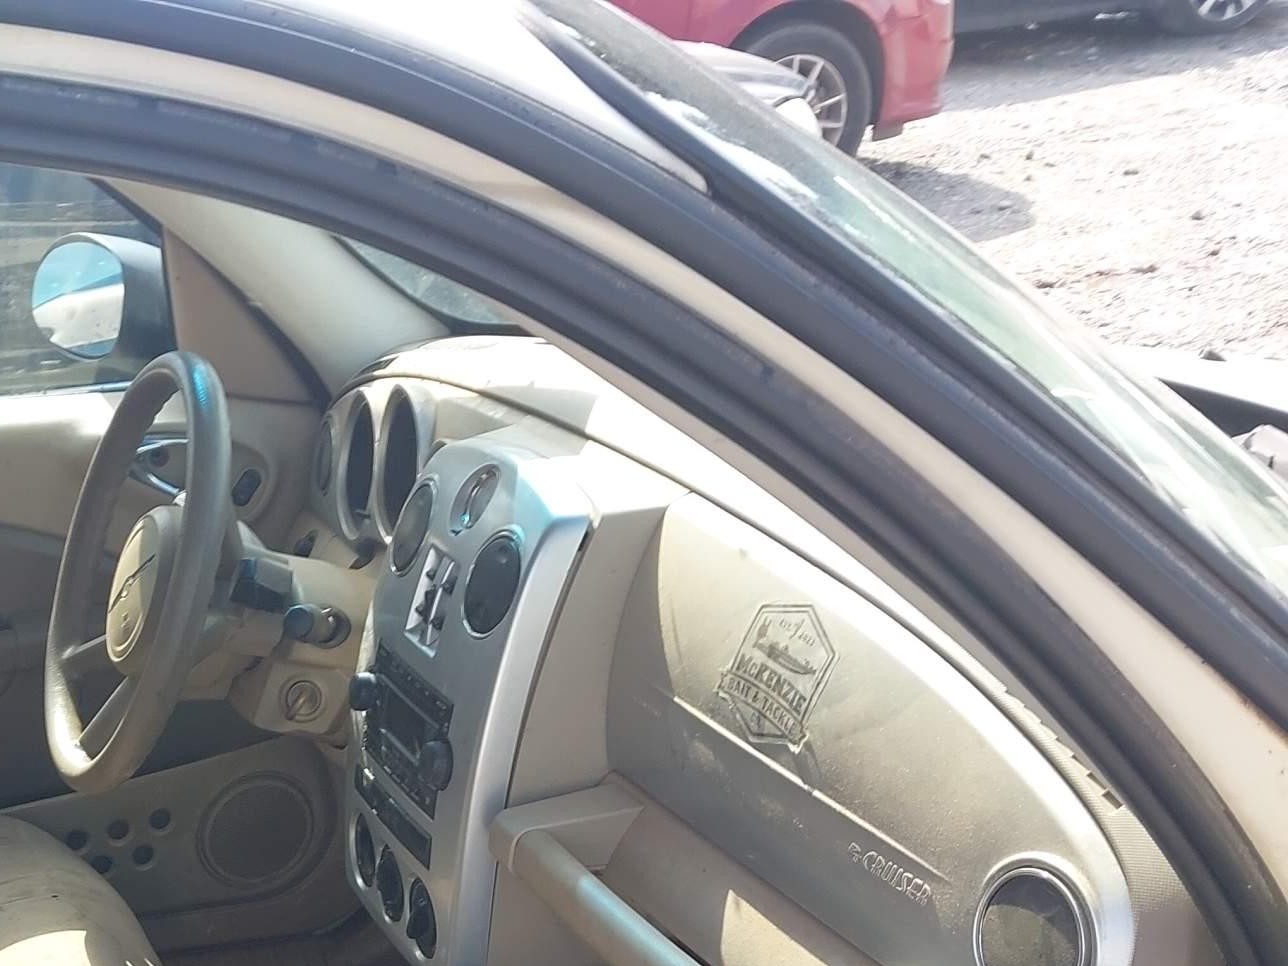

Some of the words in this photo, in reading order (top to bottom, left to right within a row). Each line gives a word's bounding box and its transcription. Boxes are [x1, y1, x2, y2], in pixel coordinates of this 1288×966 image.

[726, 678, 751, 699] BAIT
[762, 695, 798, 737] TACKLE
[863, 851, 931, 905] CRUISER
